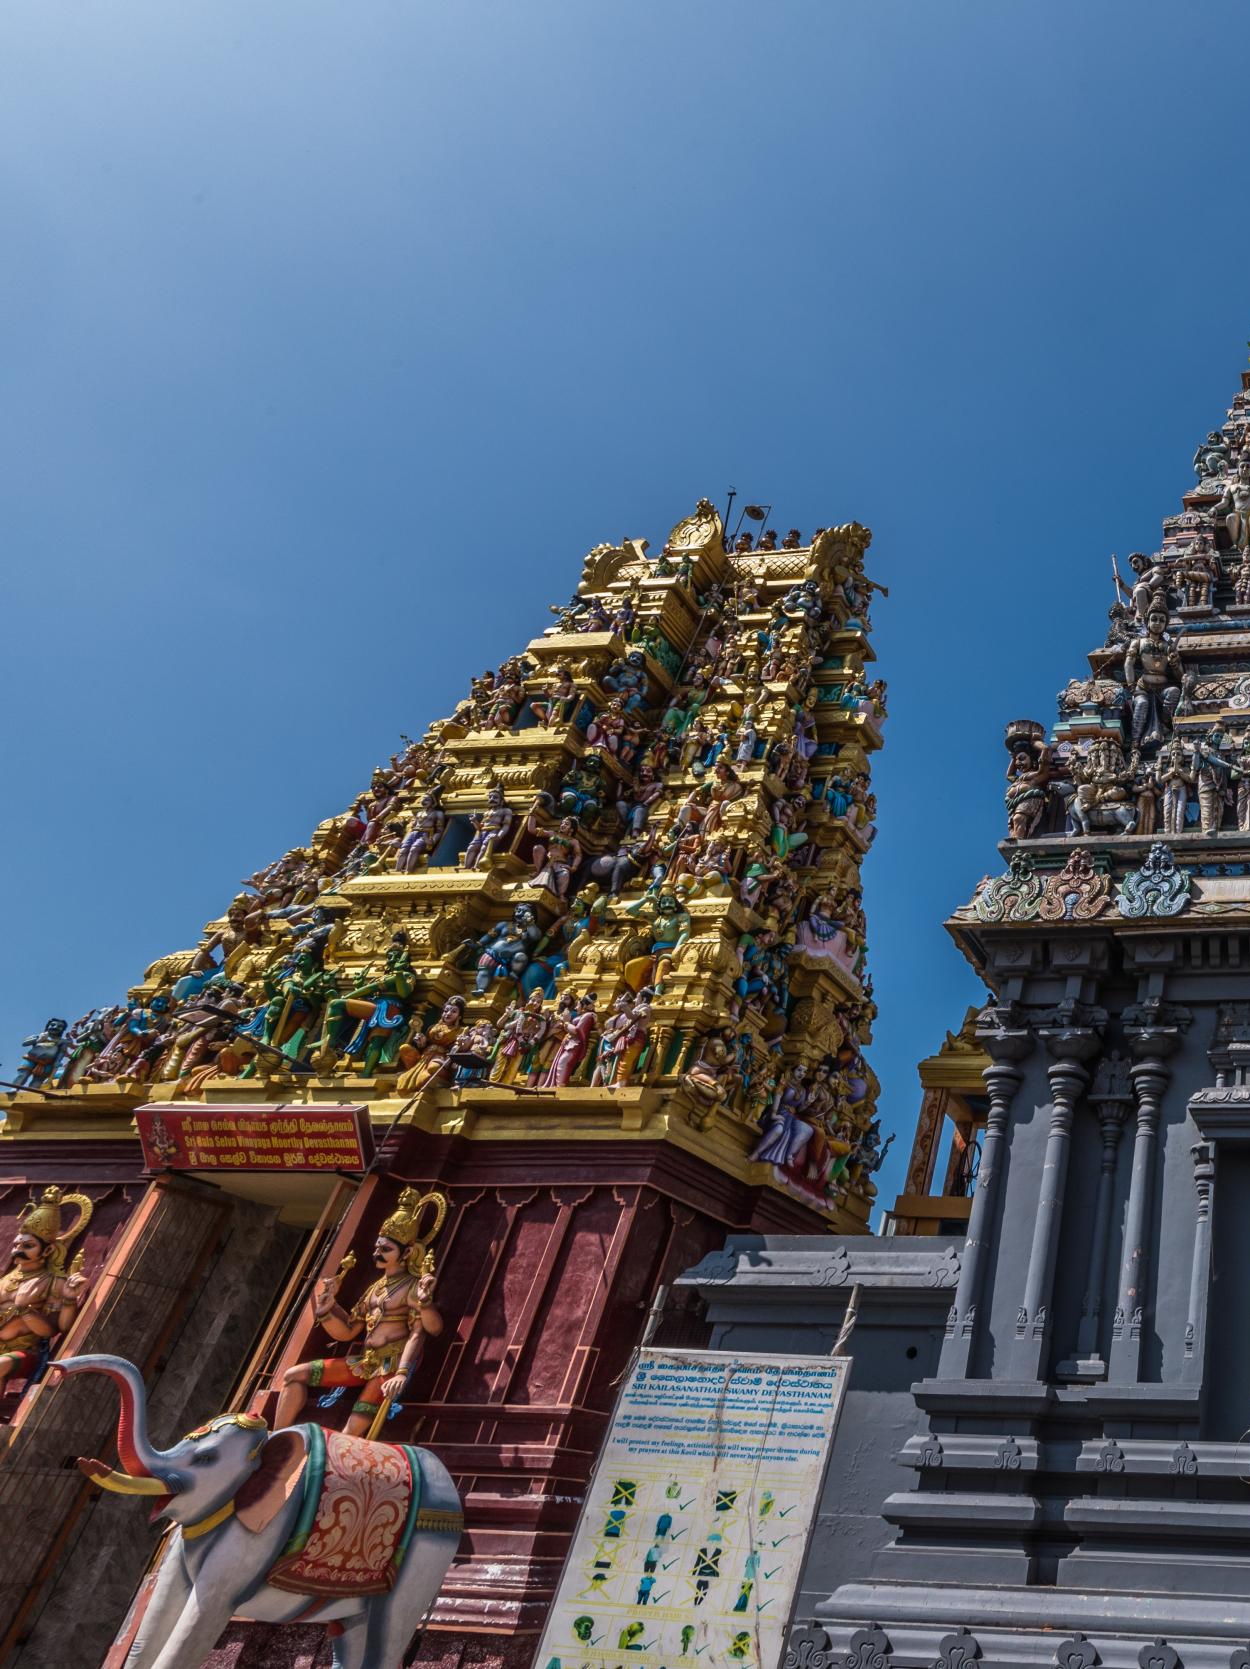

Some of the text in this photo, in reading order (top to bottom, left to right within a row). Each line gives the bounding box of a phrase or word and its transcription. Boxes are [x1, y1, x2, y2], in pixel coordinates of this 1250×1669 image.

[184, 1136, 196, 1147] Sri
[215, 1136, 237, 1148] Selva
[304, 1136, 358, 1149] Devasthanam
[631, 1383, 647, 1391] SRI
[648, 1383, 724, 1395] KAILASANATHAR
[725, 1387, 760, 1397] SWAMY
[762, 1390, 833, 1400] DEVASTHANAM
